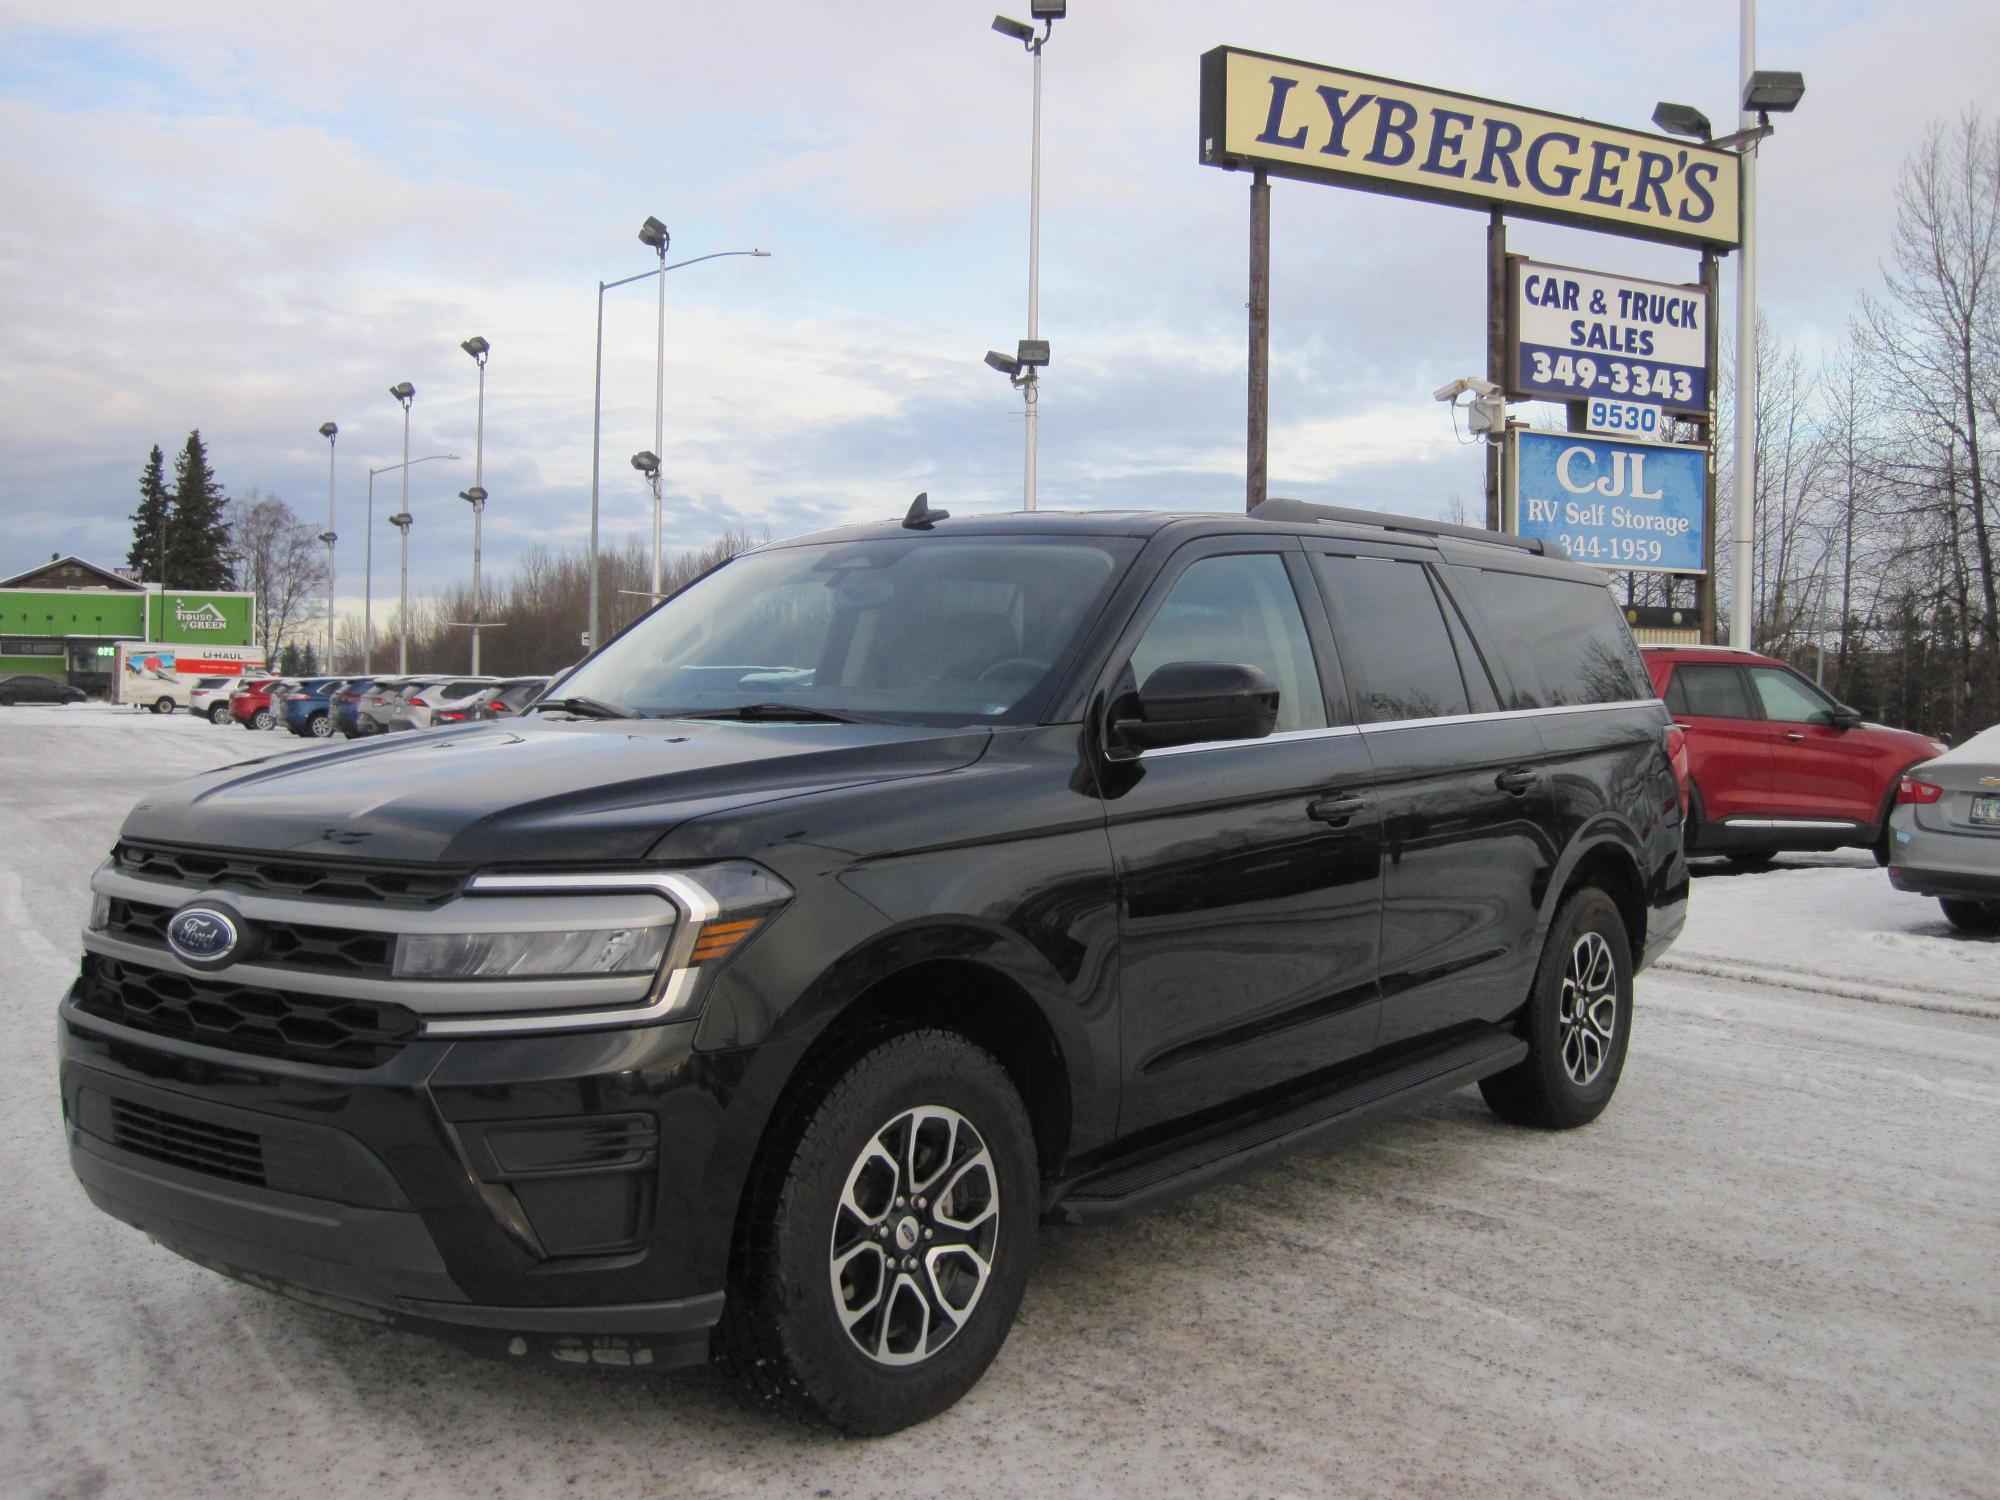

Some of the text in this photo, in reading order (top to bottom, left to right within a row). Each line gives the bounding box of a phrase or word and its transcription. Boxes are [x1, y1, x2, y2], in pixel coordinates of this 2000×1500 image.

[1255, 75, 1719, 224] LYBERGER'S
[1524, 274, 1698, 330] CAR & TRUCK
[1569, 319, 1654, 356] SALES
[1531, 351, 1693, 402] 349-3343
[1591, 402, 1656, 432] 9530
[1556, 446, 1663, 500] CJL
[1528, 499, 1689, 536] RV Self Storage
[1560, 534, 1662, 562] 344-1959
[189, 621, 227, 630] GREEN
[97, 647, 115, 656] OPE
